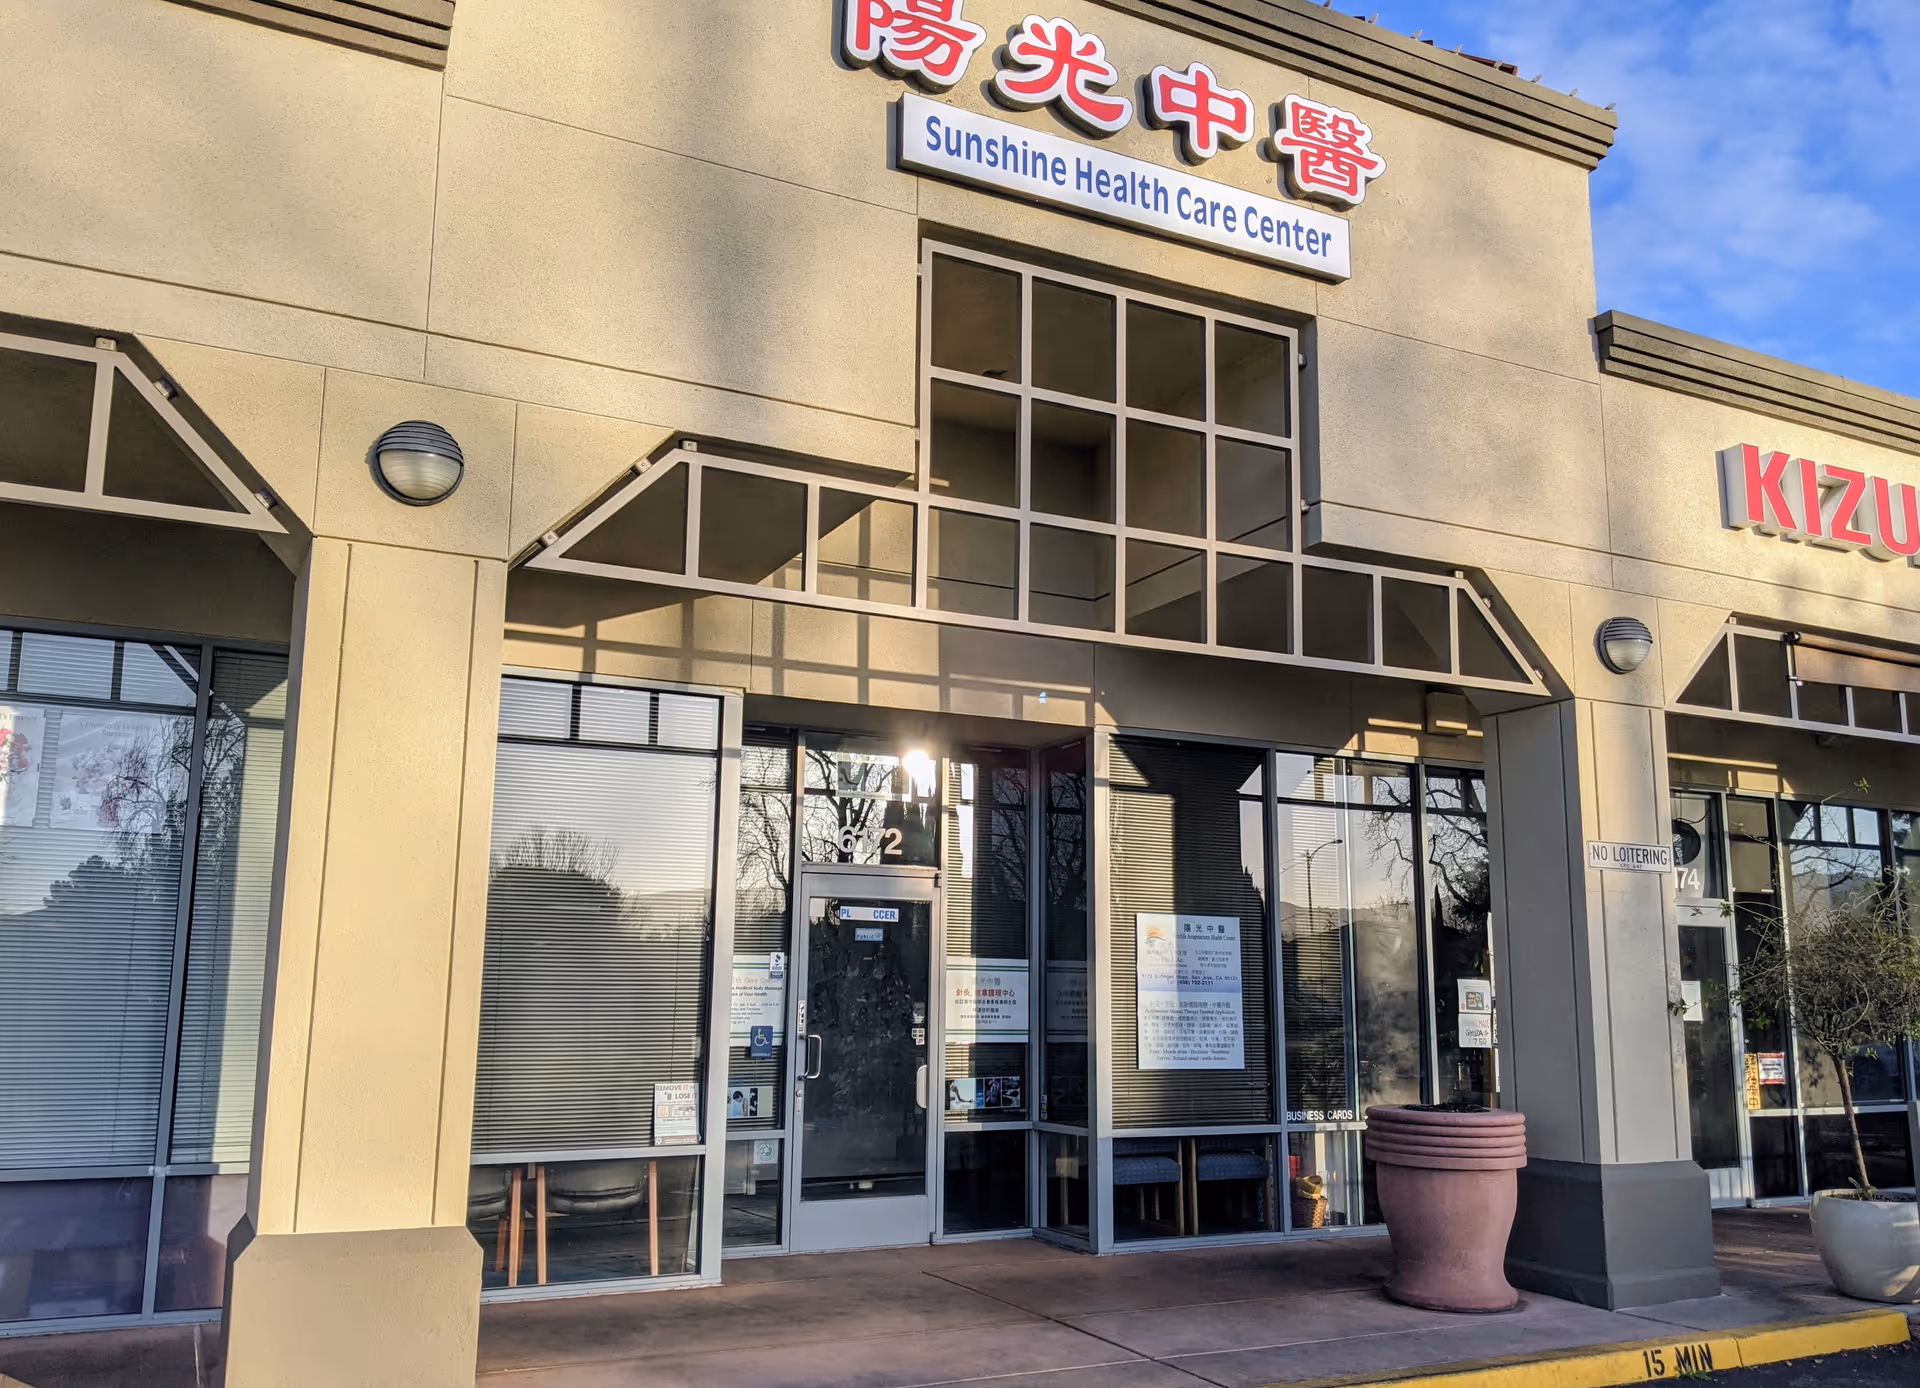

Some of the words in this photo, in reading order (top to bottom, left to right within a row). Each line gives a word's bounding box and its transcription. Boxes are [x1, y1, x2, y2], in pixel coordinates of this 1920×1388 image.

[925, 115, 1067, 186] Sunshine
[1074, 157, 1169, 214] Health
[1176, 186, 1237, 234] Care
[1244, 205, 1332, 258] Center
[1742, 442, 1920, 556] KIZU
[839, 825, 903, 855] 6172
[1592, 845, 1608, 861] NO
[1612, 846, 1668, 866] LOITERING
[1465, 1029, 1484, 1037] GYOZA
[1286, 1110, 1325, 1121] BUSINESS
[1327, 1109, 1353, 1120] CARDS
[1642, 1349, 1666, 1377] 15
[1674, 1342, 1715, 1373] MIN
